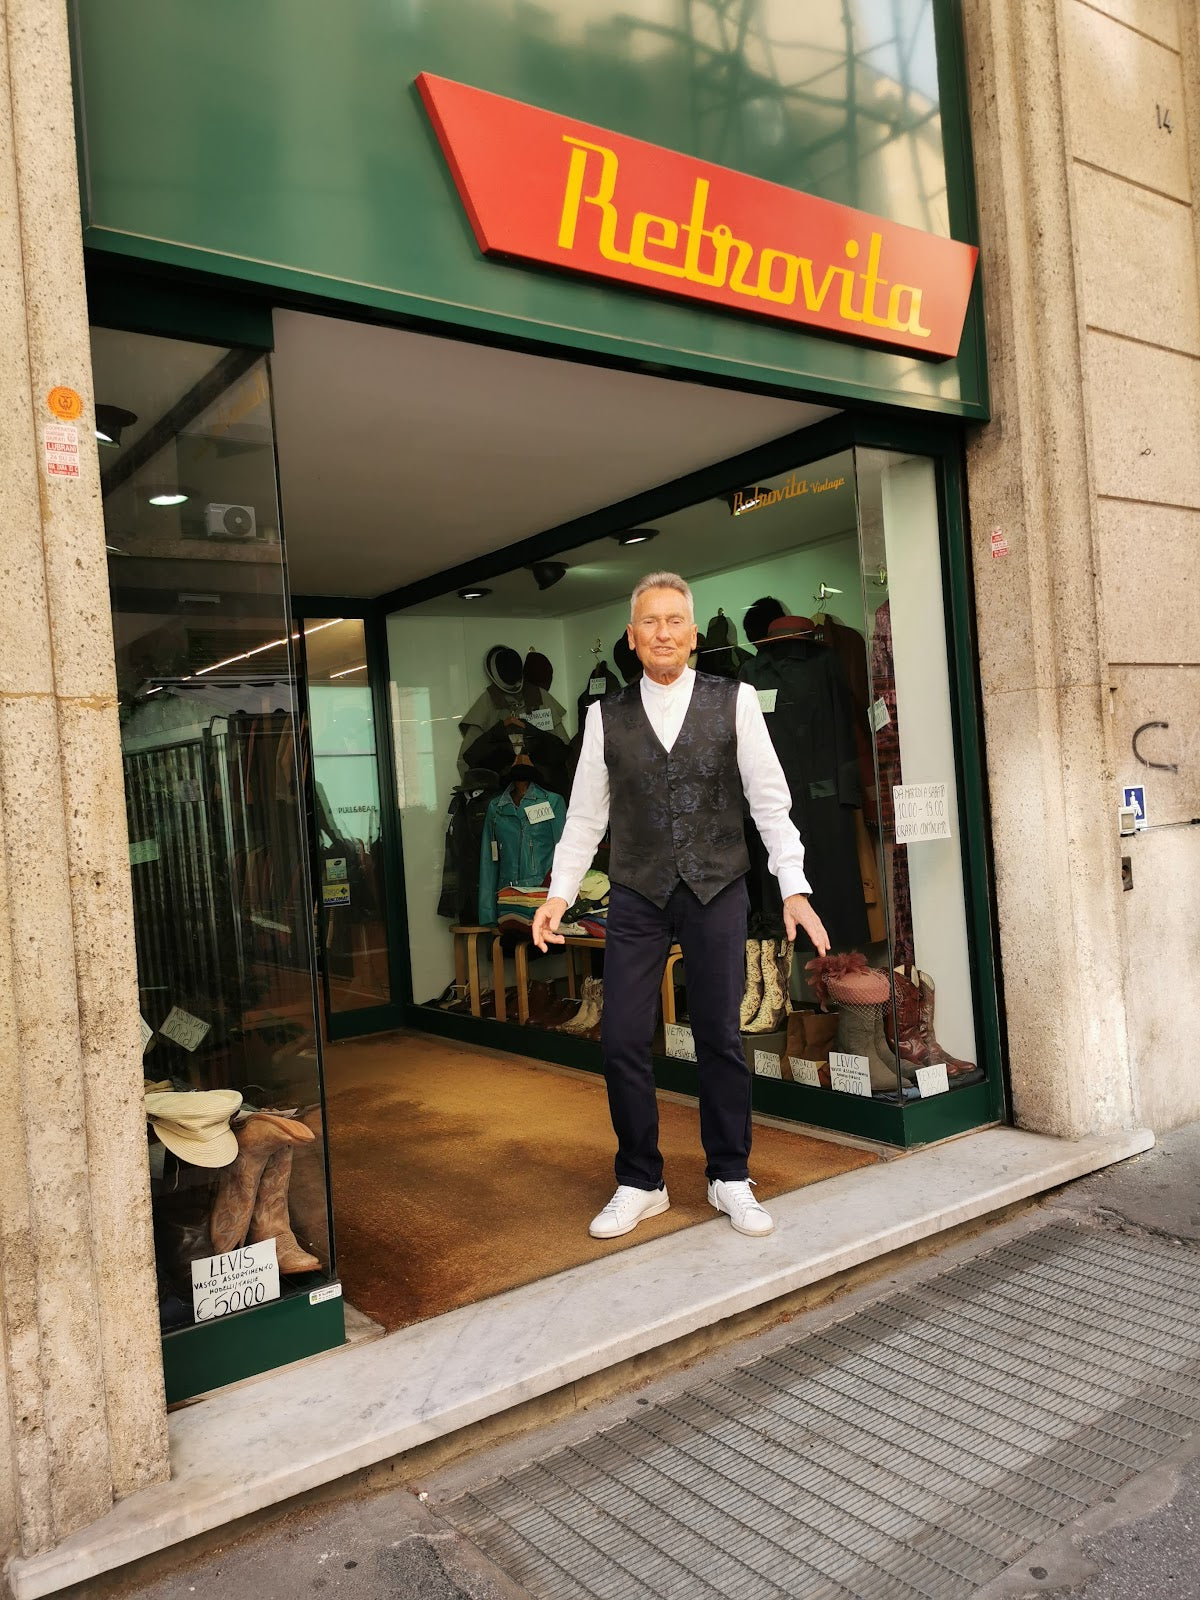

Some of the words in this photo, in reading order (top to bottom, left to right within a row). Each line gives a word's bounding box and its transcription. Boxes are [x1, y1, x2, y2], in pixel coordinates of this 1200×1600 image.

[557, 134, 932, 338] Retrovita
[732, 473, 809, 517] Retrovita
[666, 1025, 693, 1037] VETRIN
[836, 1054, 861, 1070] LEVIS
[193, 1279, 217, 1291] VASTO
[222, 1263, 274, 1283] ASSORTIMENTO
[210, 1246, 255, 1278] LEVIS
